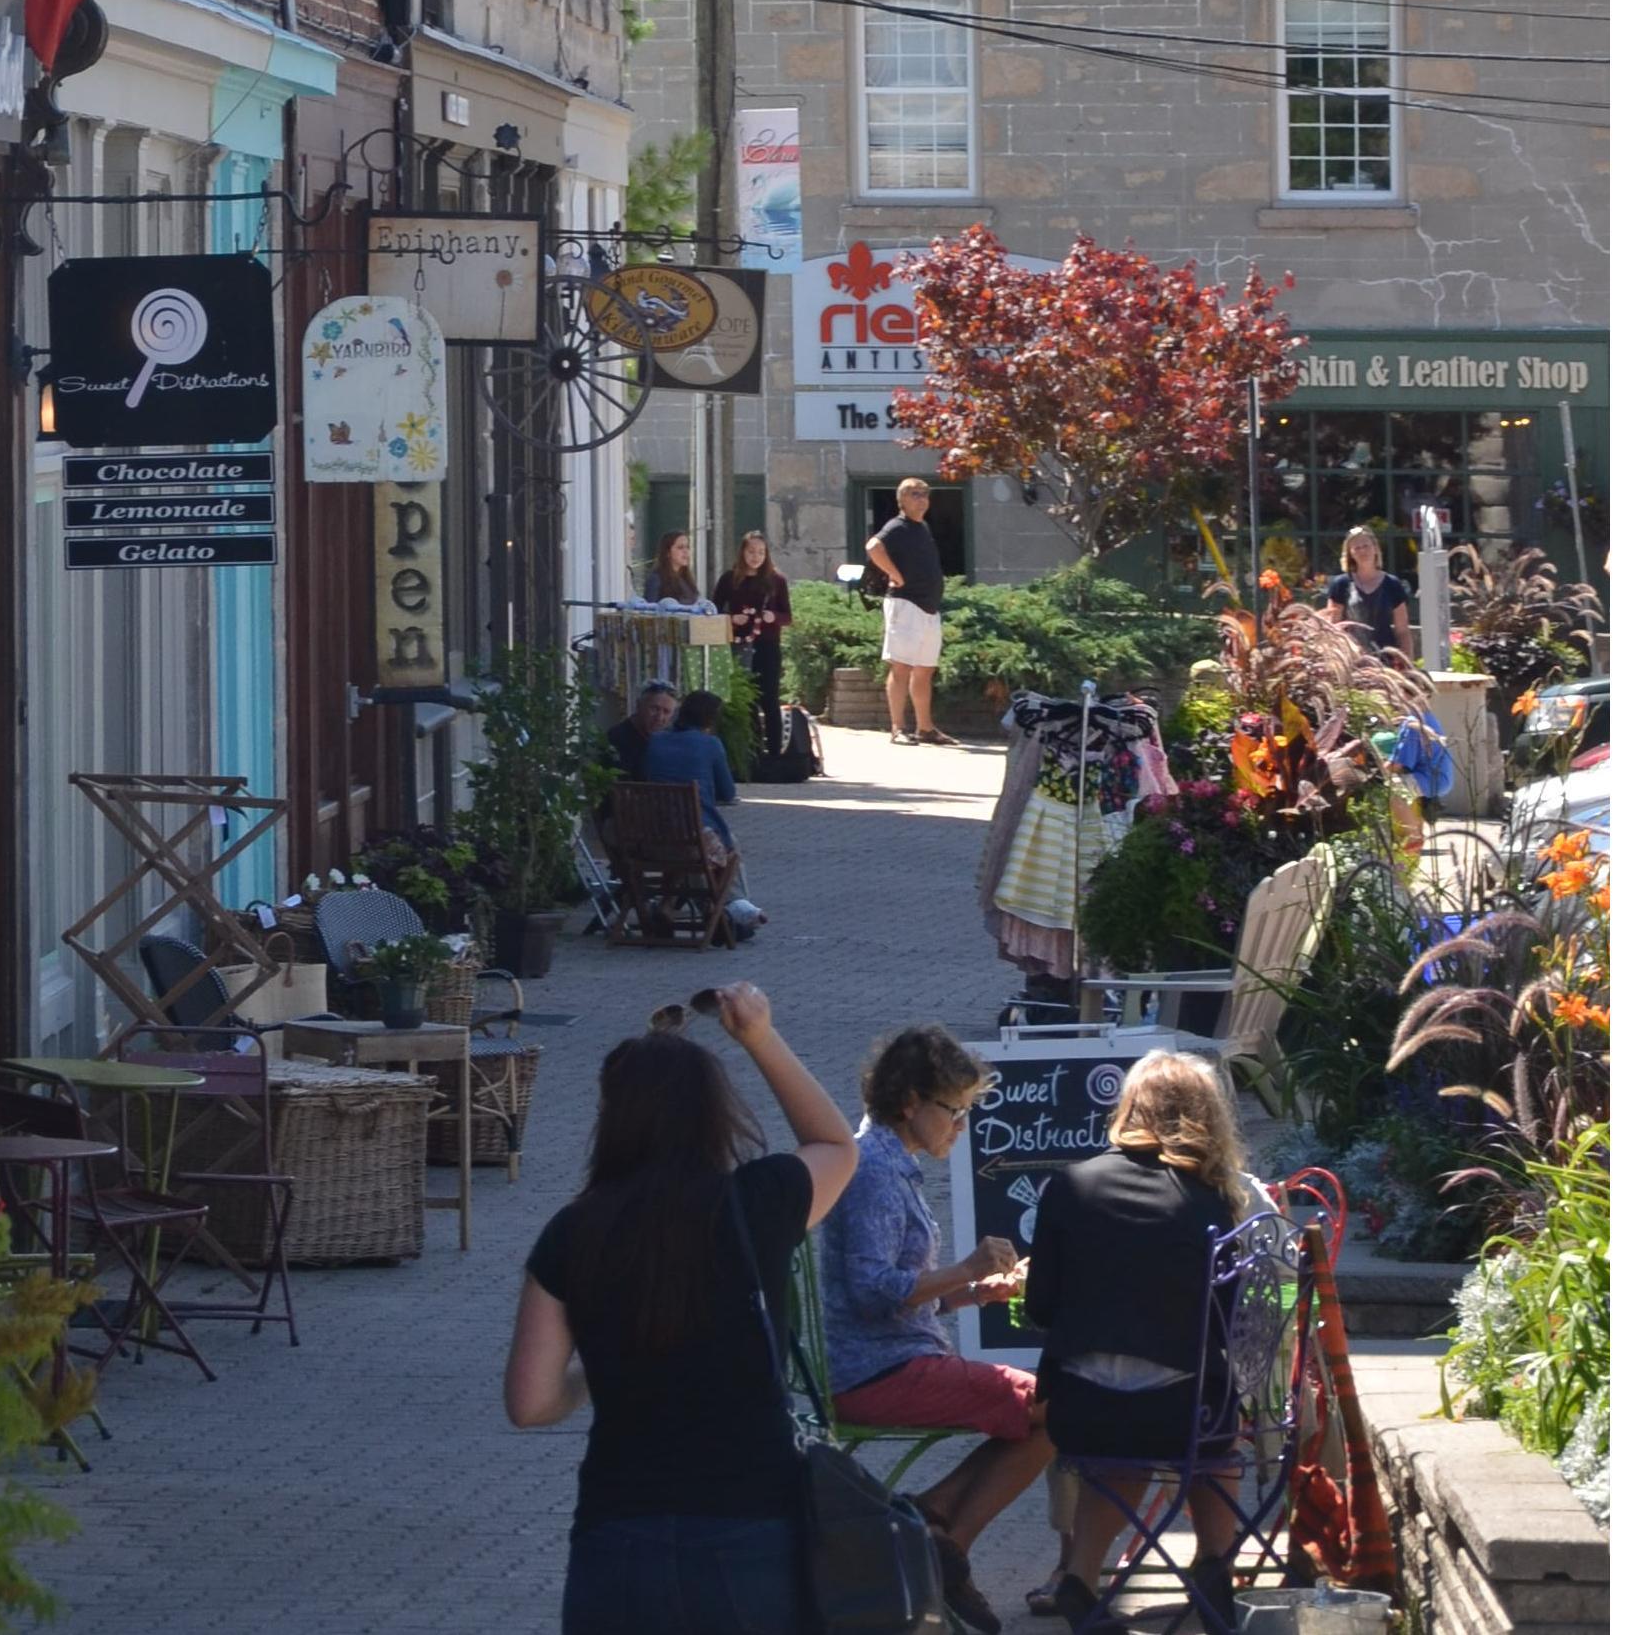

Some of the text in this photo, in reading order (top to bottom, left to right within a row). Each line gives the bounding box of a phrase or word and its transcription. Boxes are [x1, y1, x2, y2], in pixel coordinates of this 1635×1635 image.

[377, 226, 529, 259] Epiphany.
[332, 342, 412, 359] YARNBIRD
[58, 372, 270, 393] Sweet Distractions
[1366, 355, 1390, 388] &
[1398, 355, 1509, 389] Leather
[1517, 356, 1589, 393] Shop
[837, 403, 879, 429] The
[96, 462, 244, 481] Chocolate
[91, 499, 246, 520] Lemonade
[118, 544, 215, 561] Gelato
[388, 482, 436, 668] pen
[978, 1065, 1069, 1110] Sweet
[975, 1110, 1113, 1155] Distracti
